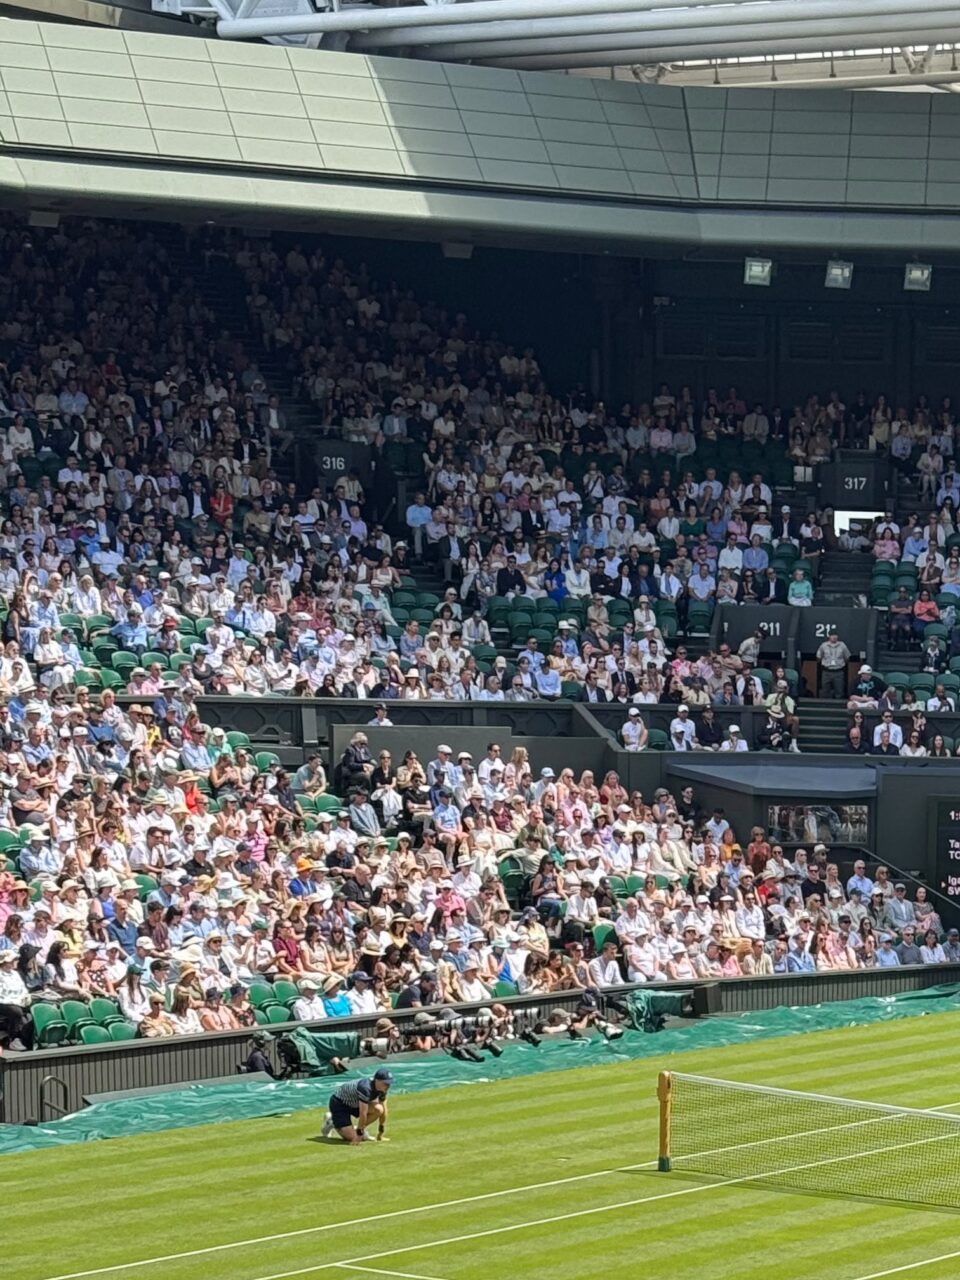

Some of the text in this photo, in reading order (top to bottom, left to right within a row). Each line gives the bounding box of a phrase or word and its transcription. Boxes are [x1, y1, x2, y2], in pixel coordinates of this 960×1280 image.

[322, 456, 345, 470] 316
[844, 476, 867, 490] 317
[815, 623, 837, 638] 21
